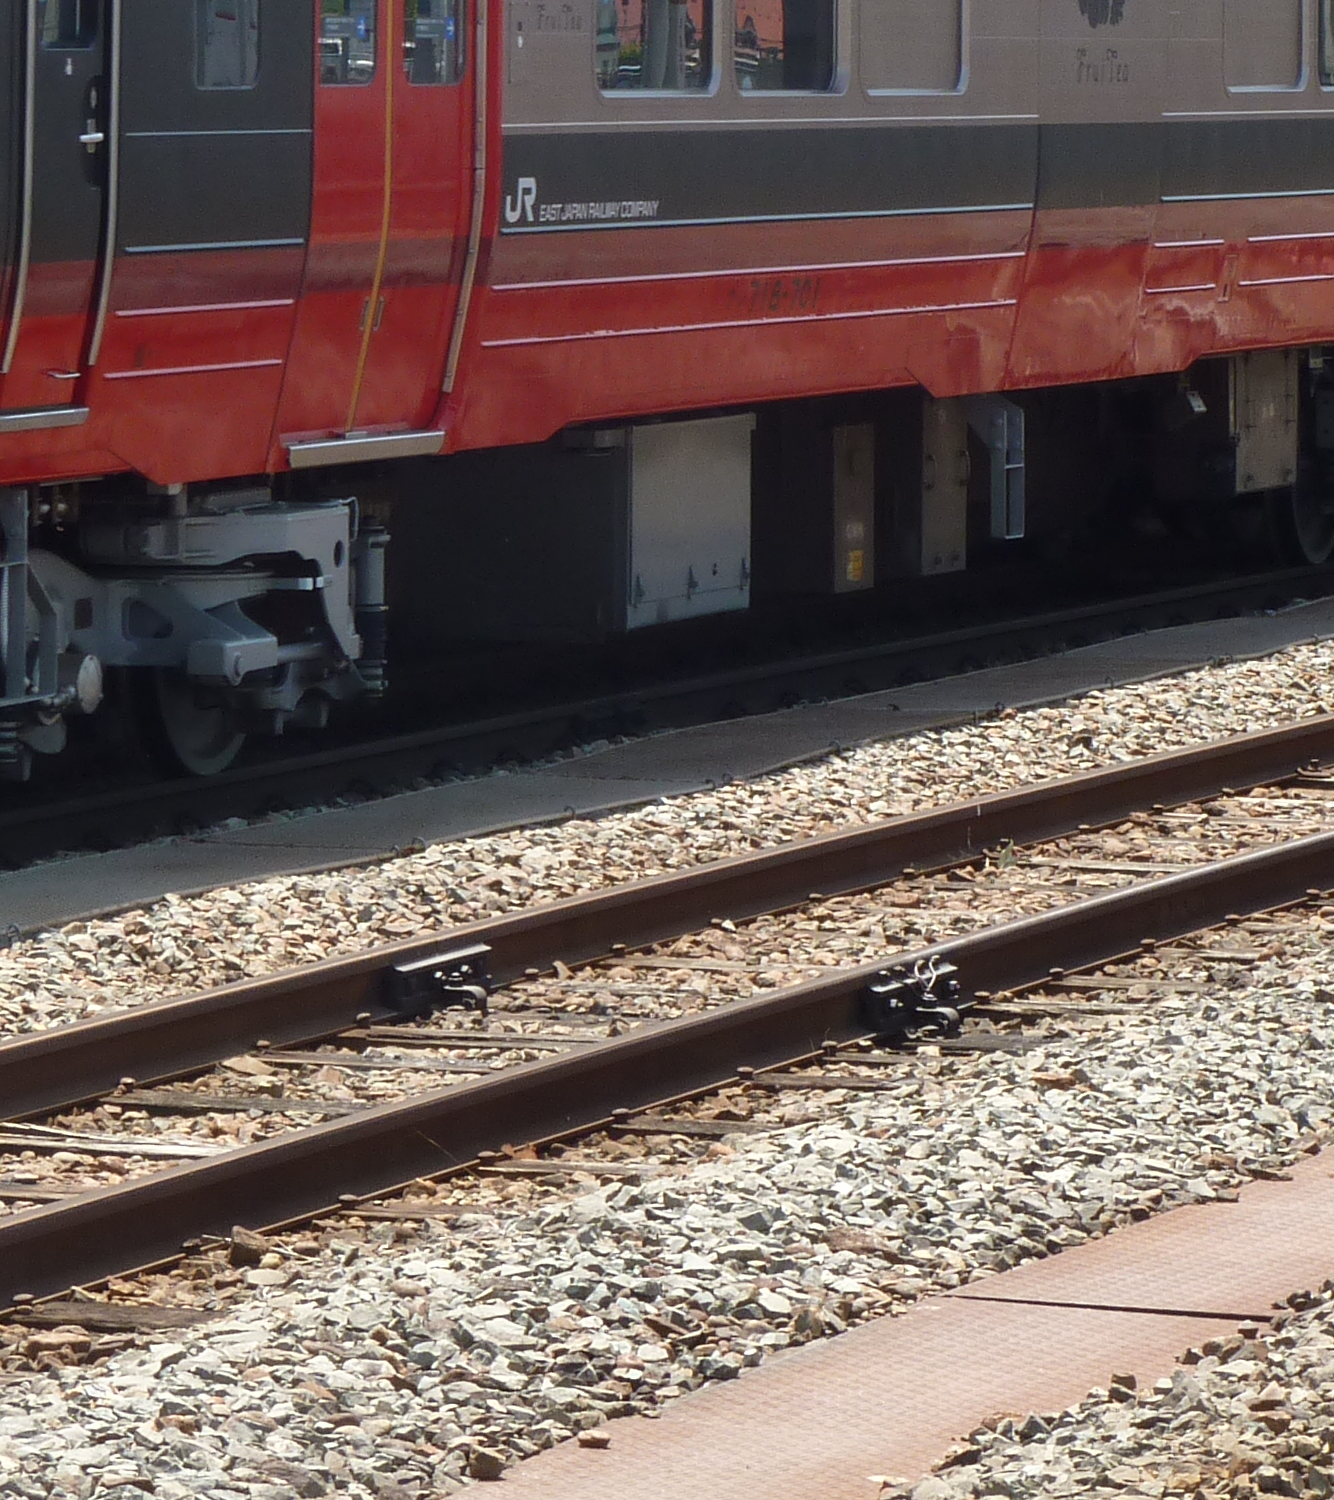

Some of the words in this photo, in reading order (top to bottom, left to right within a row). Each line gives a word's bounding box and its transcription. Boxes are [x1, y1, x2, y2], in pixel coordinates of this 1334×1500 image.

[504, 177, 537, 223] JR
[539, 203, 563, 222] EAST
[561, 202, 588, 221] JAPAN
[589, 201, 619, 219] RAILWAY
[620, 200, 660, 218] COMPANY
